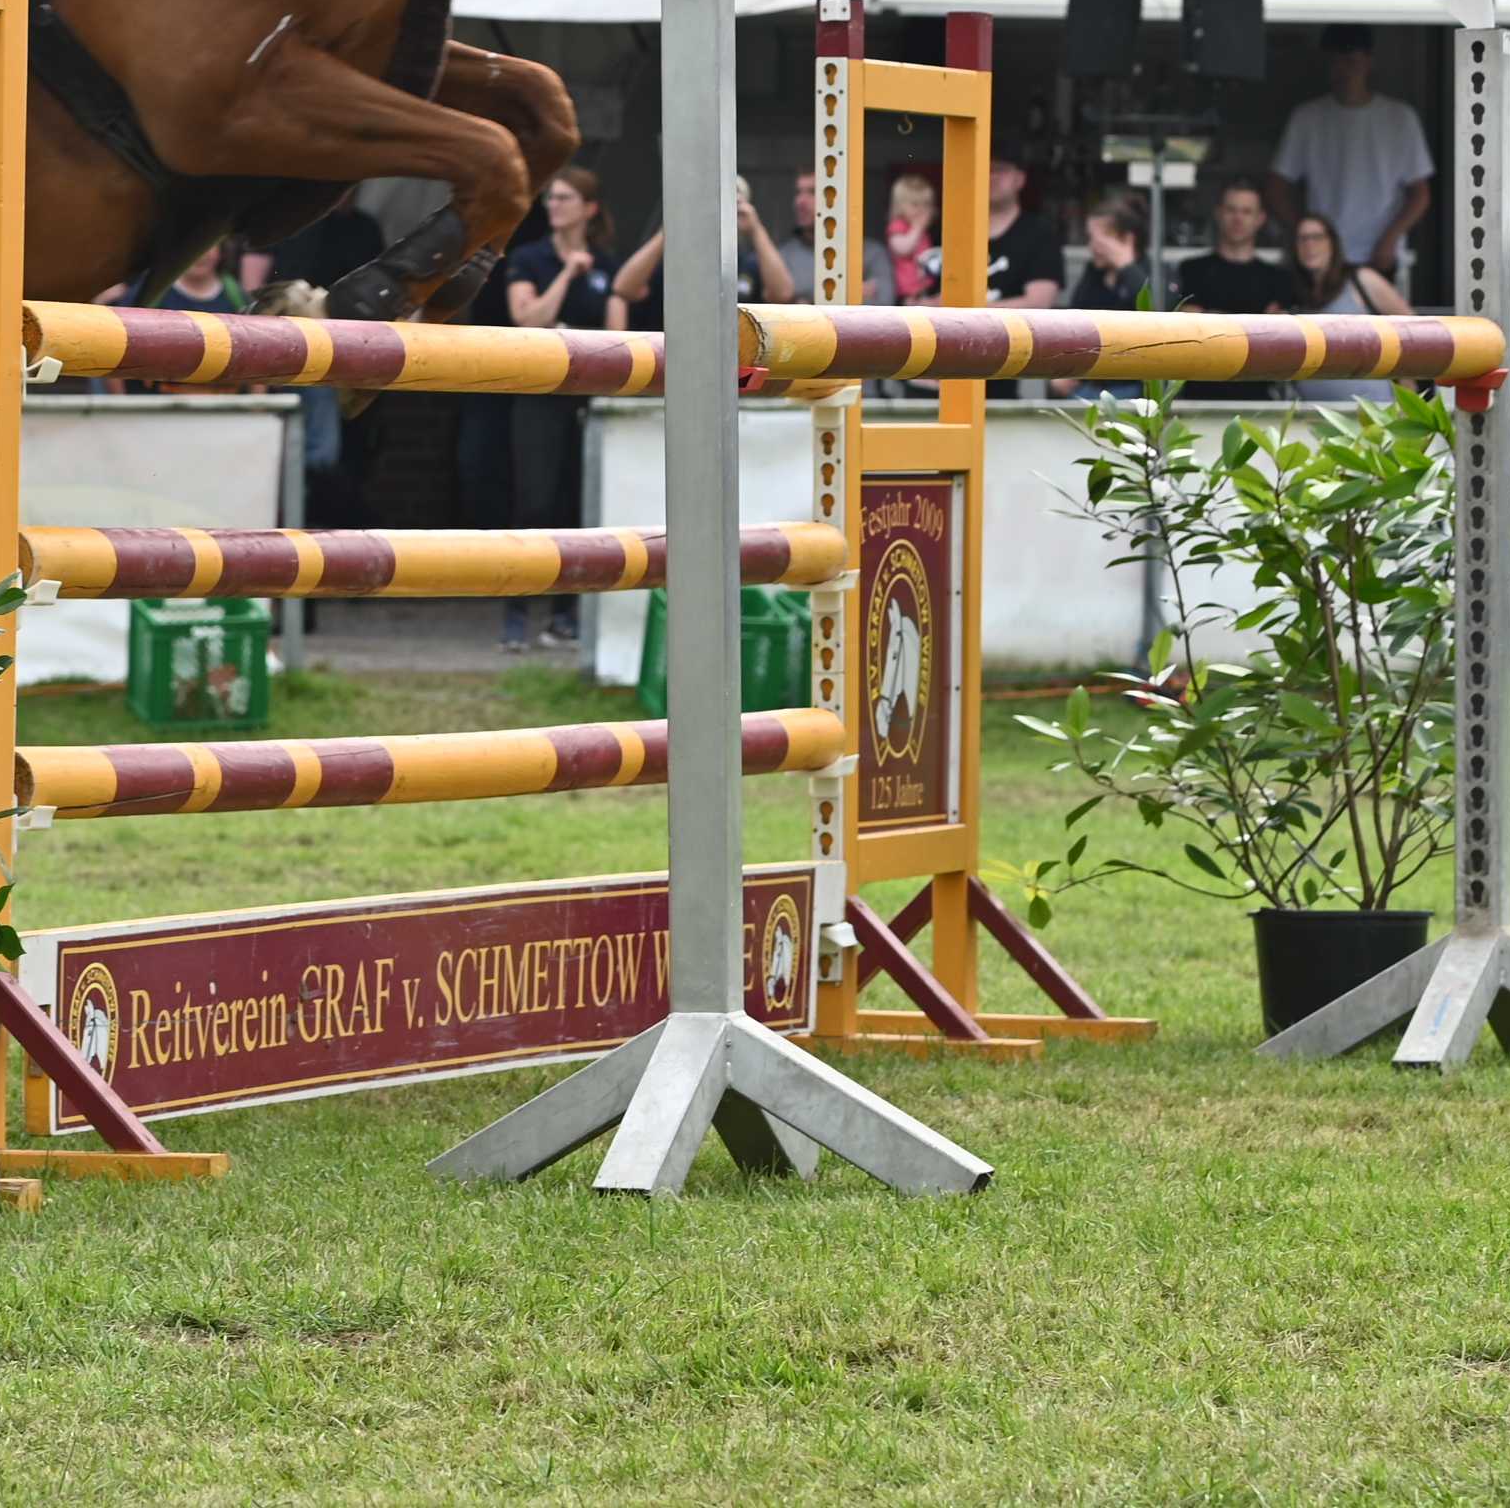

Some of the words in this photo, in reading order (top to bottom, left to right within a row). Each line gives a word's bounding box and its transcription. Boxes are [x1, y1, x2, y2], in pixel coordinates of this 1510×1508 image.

[913, 494, 945, 542] 2009
[871, 776, 892, 811] 125
[893, 773, 925, 809] Jahre
[127, 969, 289, 1070] Reitverein
[297, 957, 395, 1043] GRAF
[402, 977, 425, 1030] v.
[434, 931, 647, 1028] SCHMETTOW
